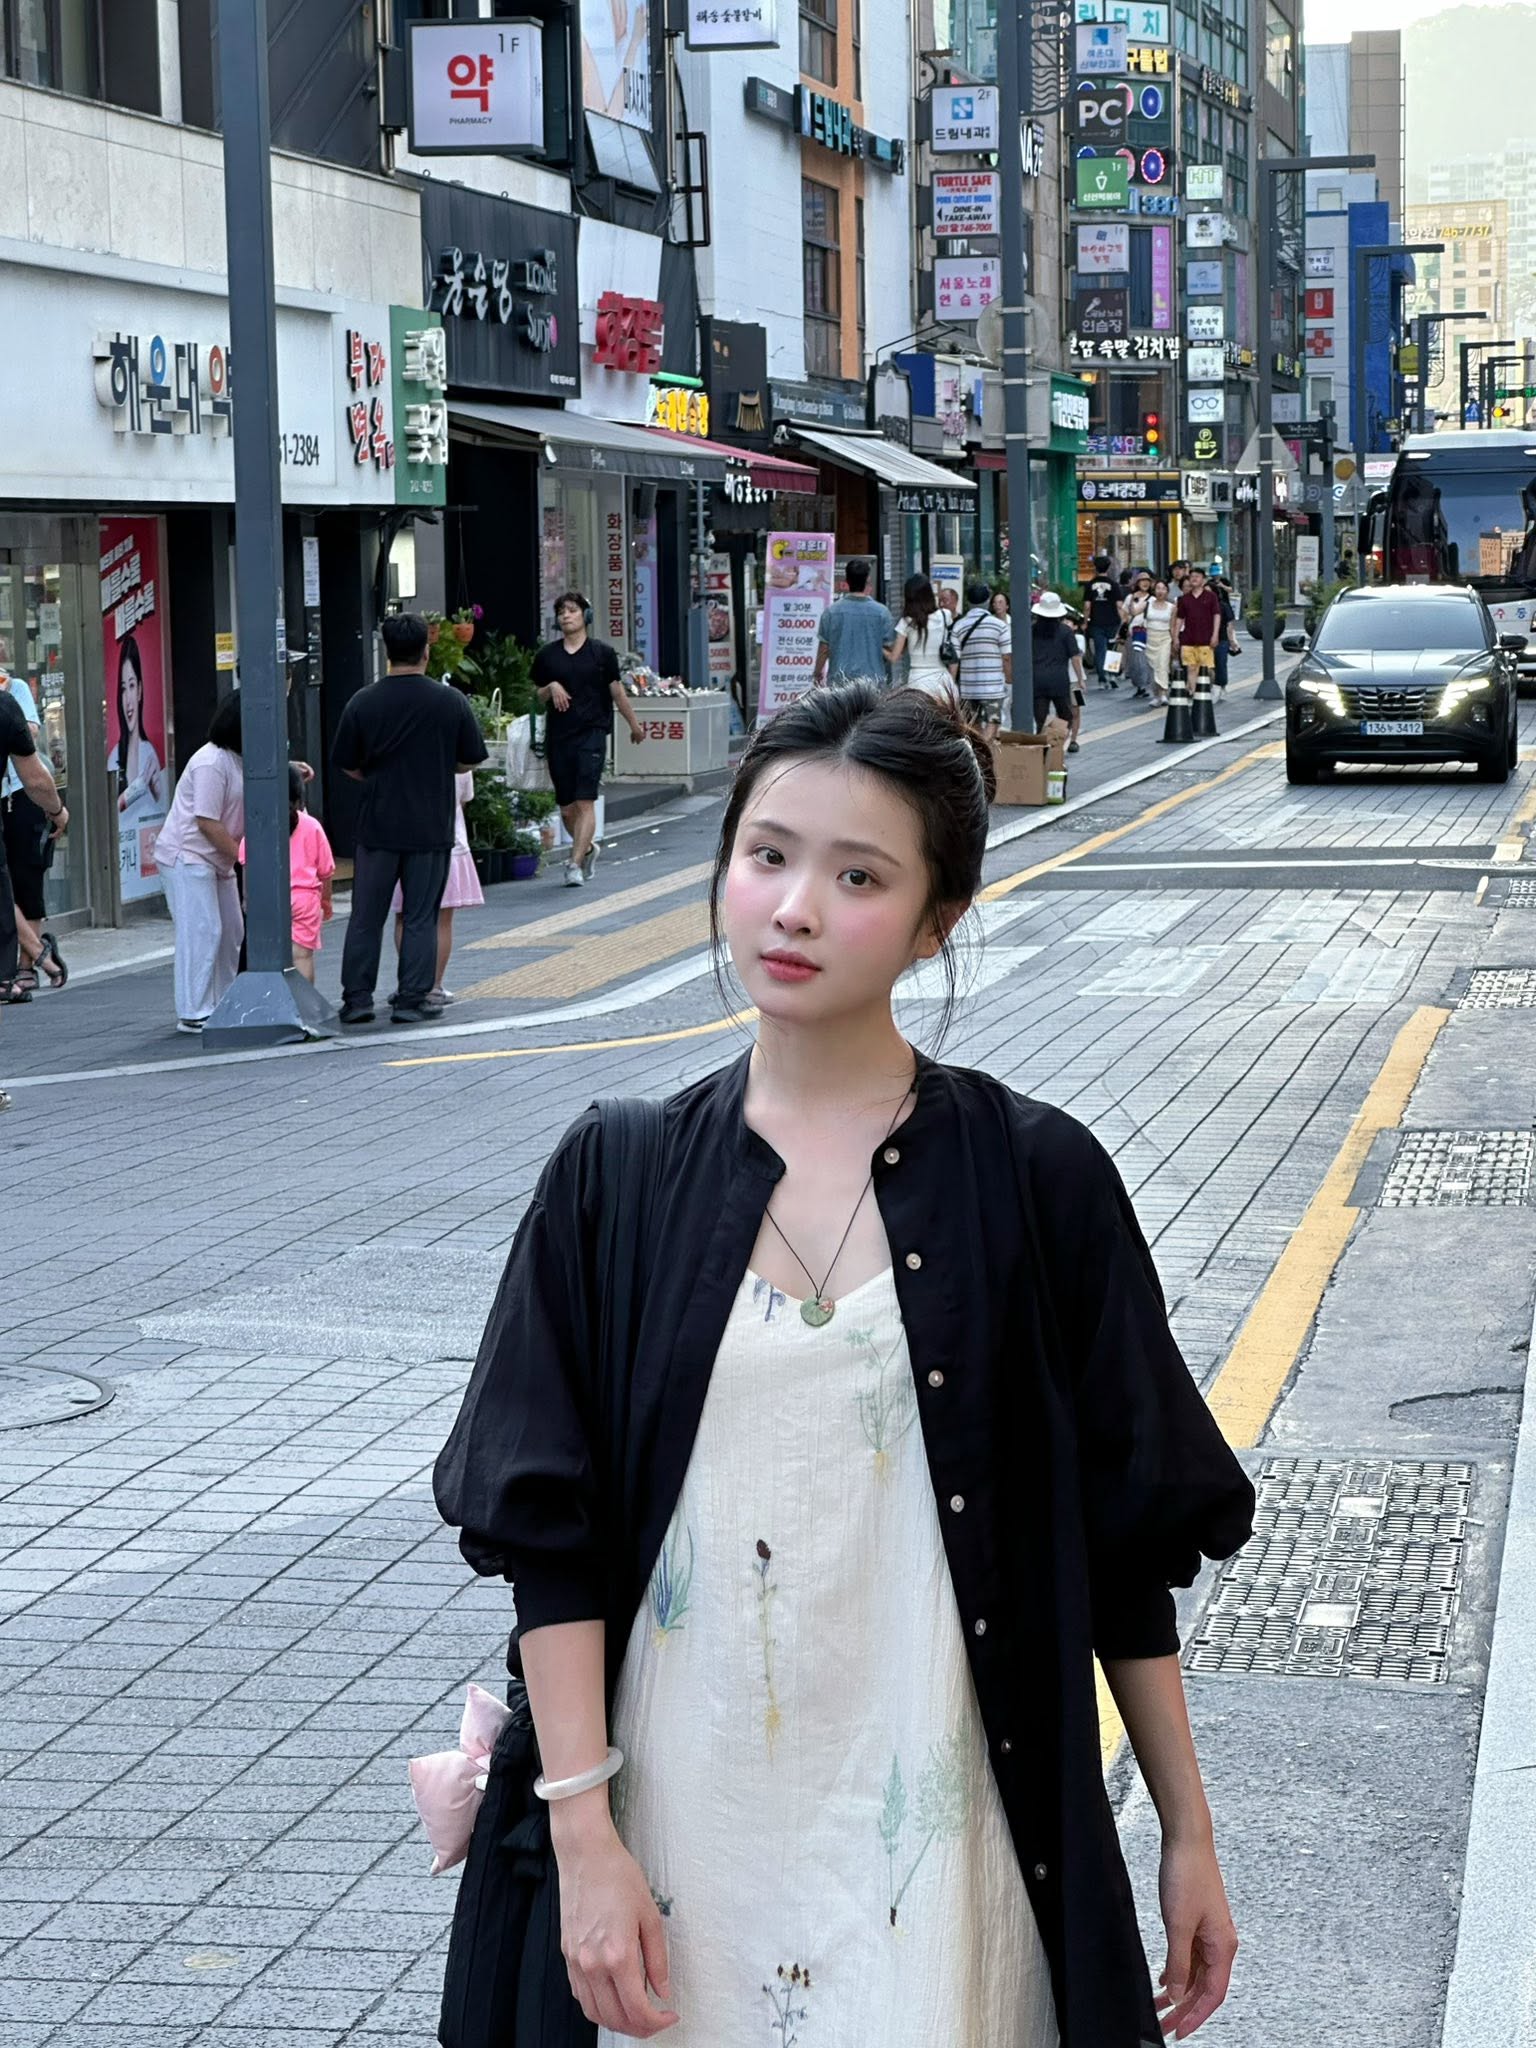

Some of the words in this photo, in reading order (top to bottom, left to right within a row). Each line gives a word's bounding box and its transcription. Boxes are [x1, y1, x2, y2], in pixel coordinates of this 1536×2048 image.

[447, 54, 494, 112] 약
[1079, 99, 1122, 128] PC
[449, 117, 493, 125] PHARMACY
[936, 176, 968, 187] TURTLE
[971, 175, 992, 186] SAFE
[953, 205, 984, 213] DINE-IN
[944, 214, 992, 222] TAKE-AWAY
[940, 276, 992, 290] 서울노래
[939, 293, 991, 307] 연습장
[1082, 320, 1122, 334] 연습장
[607, 512, 623, 572] 화장품
[608, 578, 625, 637] 전문점
[1396, 723, 1421, 734] 3412
